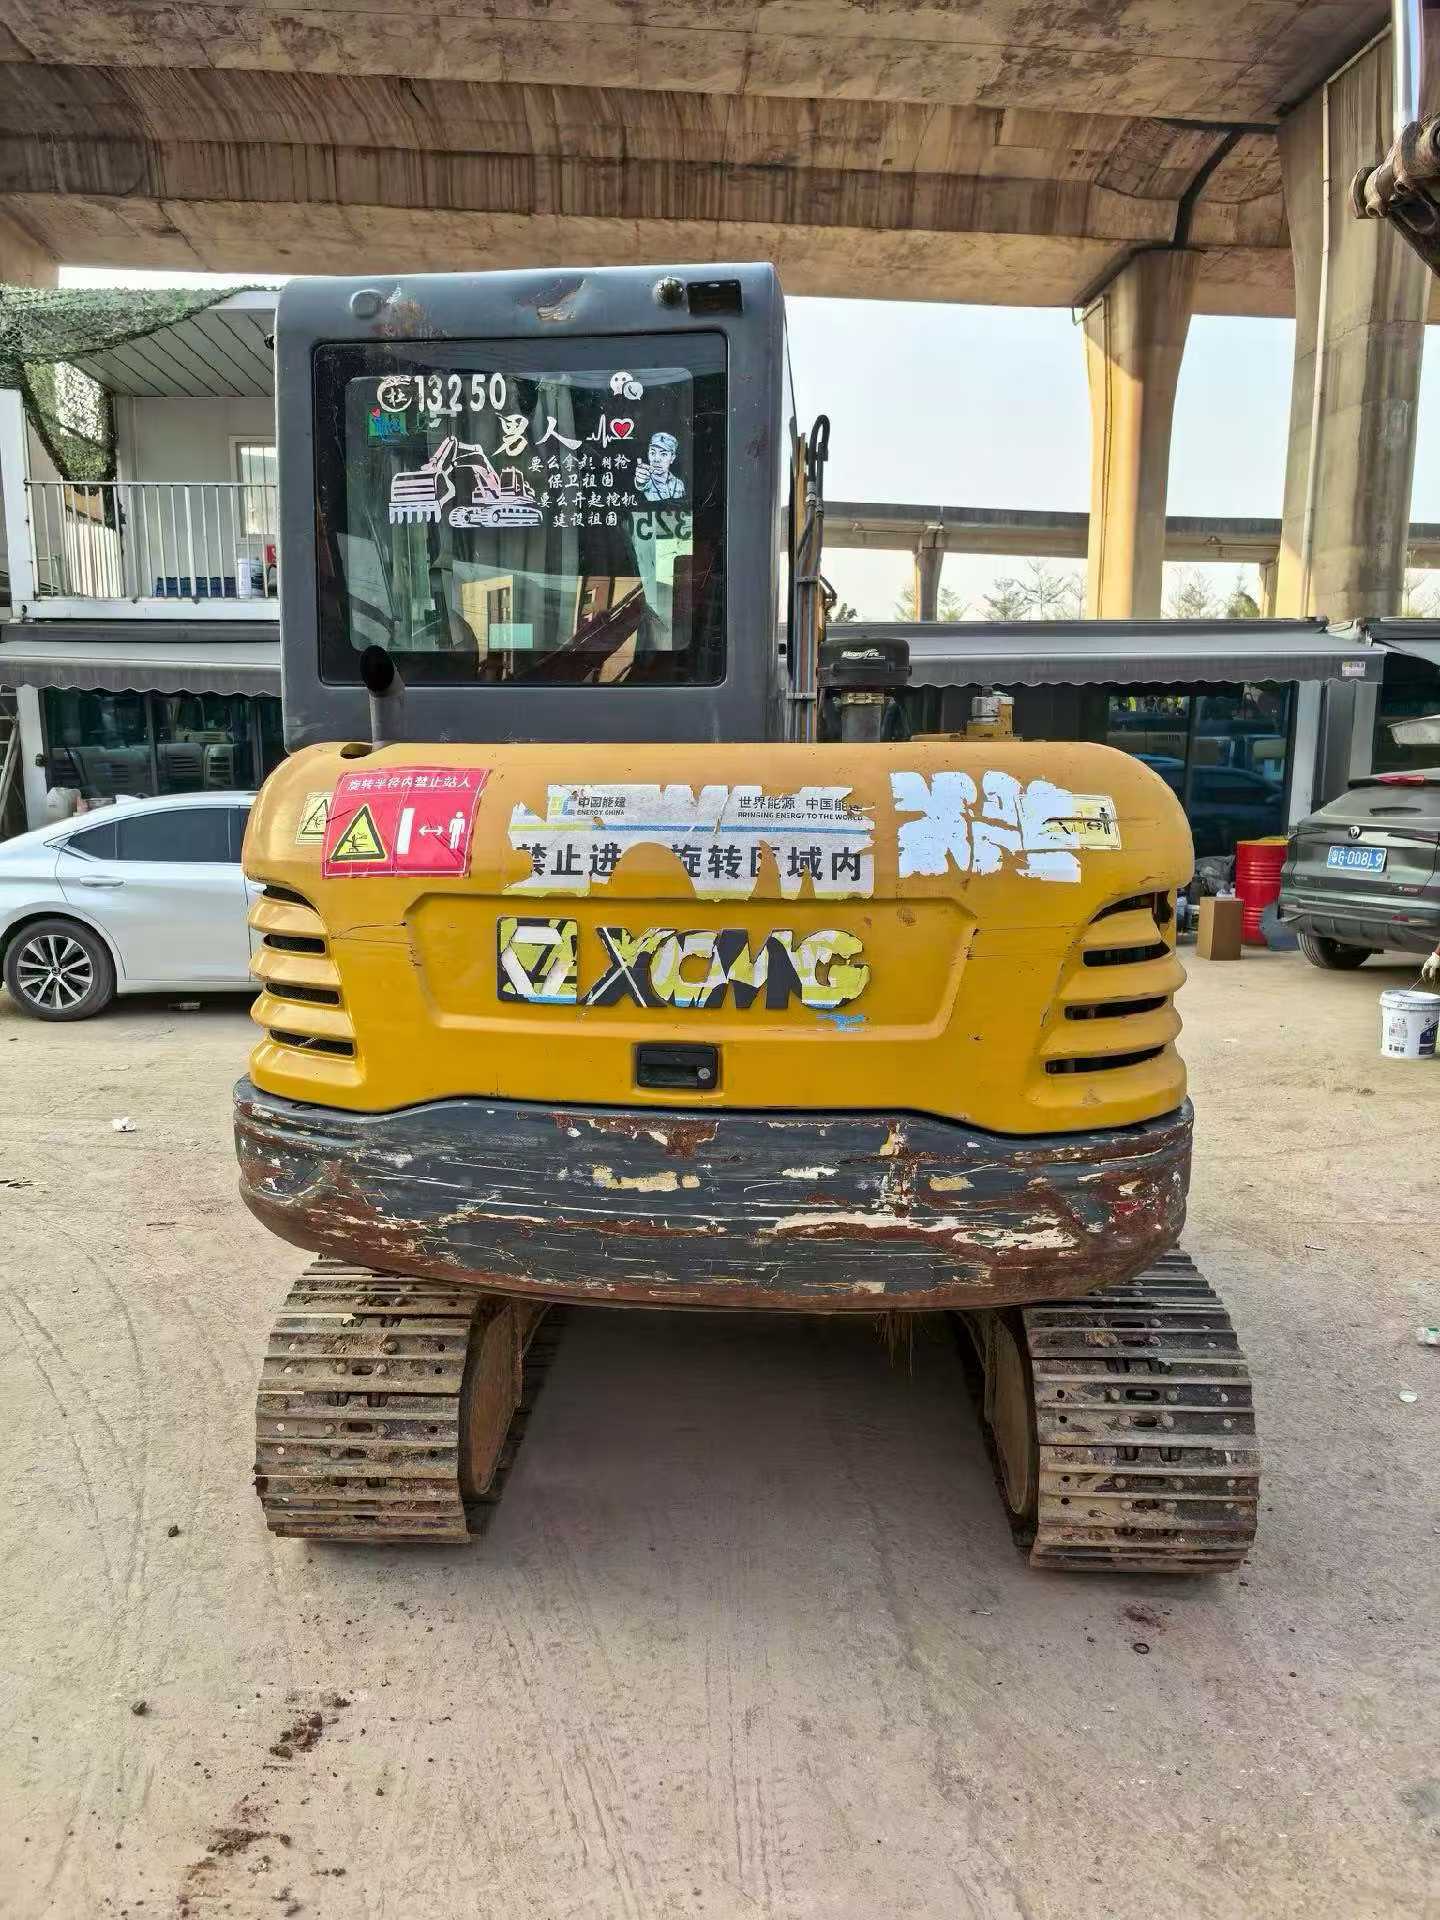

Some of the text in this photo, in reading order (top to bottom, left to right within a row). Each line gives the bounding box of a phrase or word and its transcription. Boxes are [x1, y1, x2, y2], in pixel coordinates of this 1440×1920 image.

[491, 413, 583, 456] 男人
[548, 472, 614, 489] 保卫祖国
[552, 511, 618, 528] 建设祖国
[578, 796, 626, 808] 中国能建
[739, 796, 795, 810] 世界能源
[580, 927, 872, 1009] XCMG
